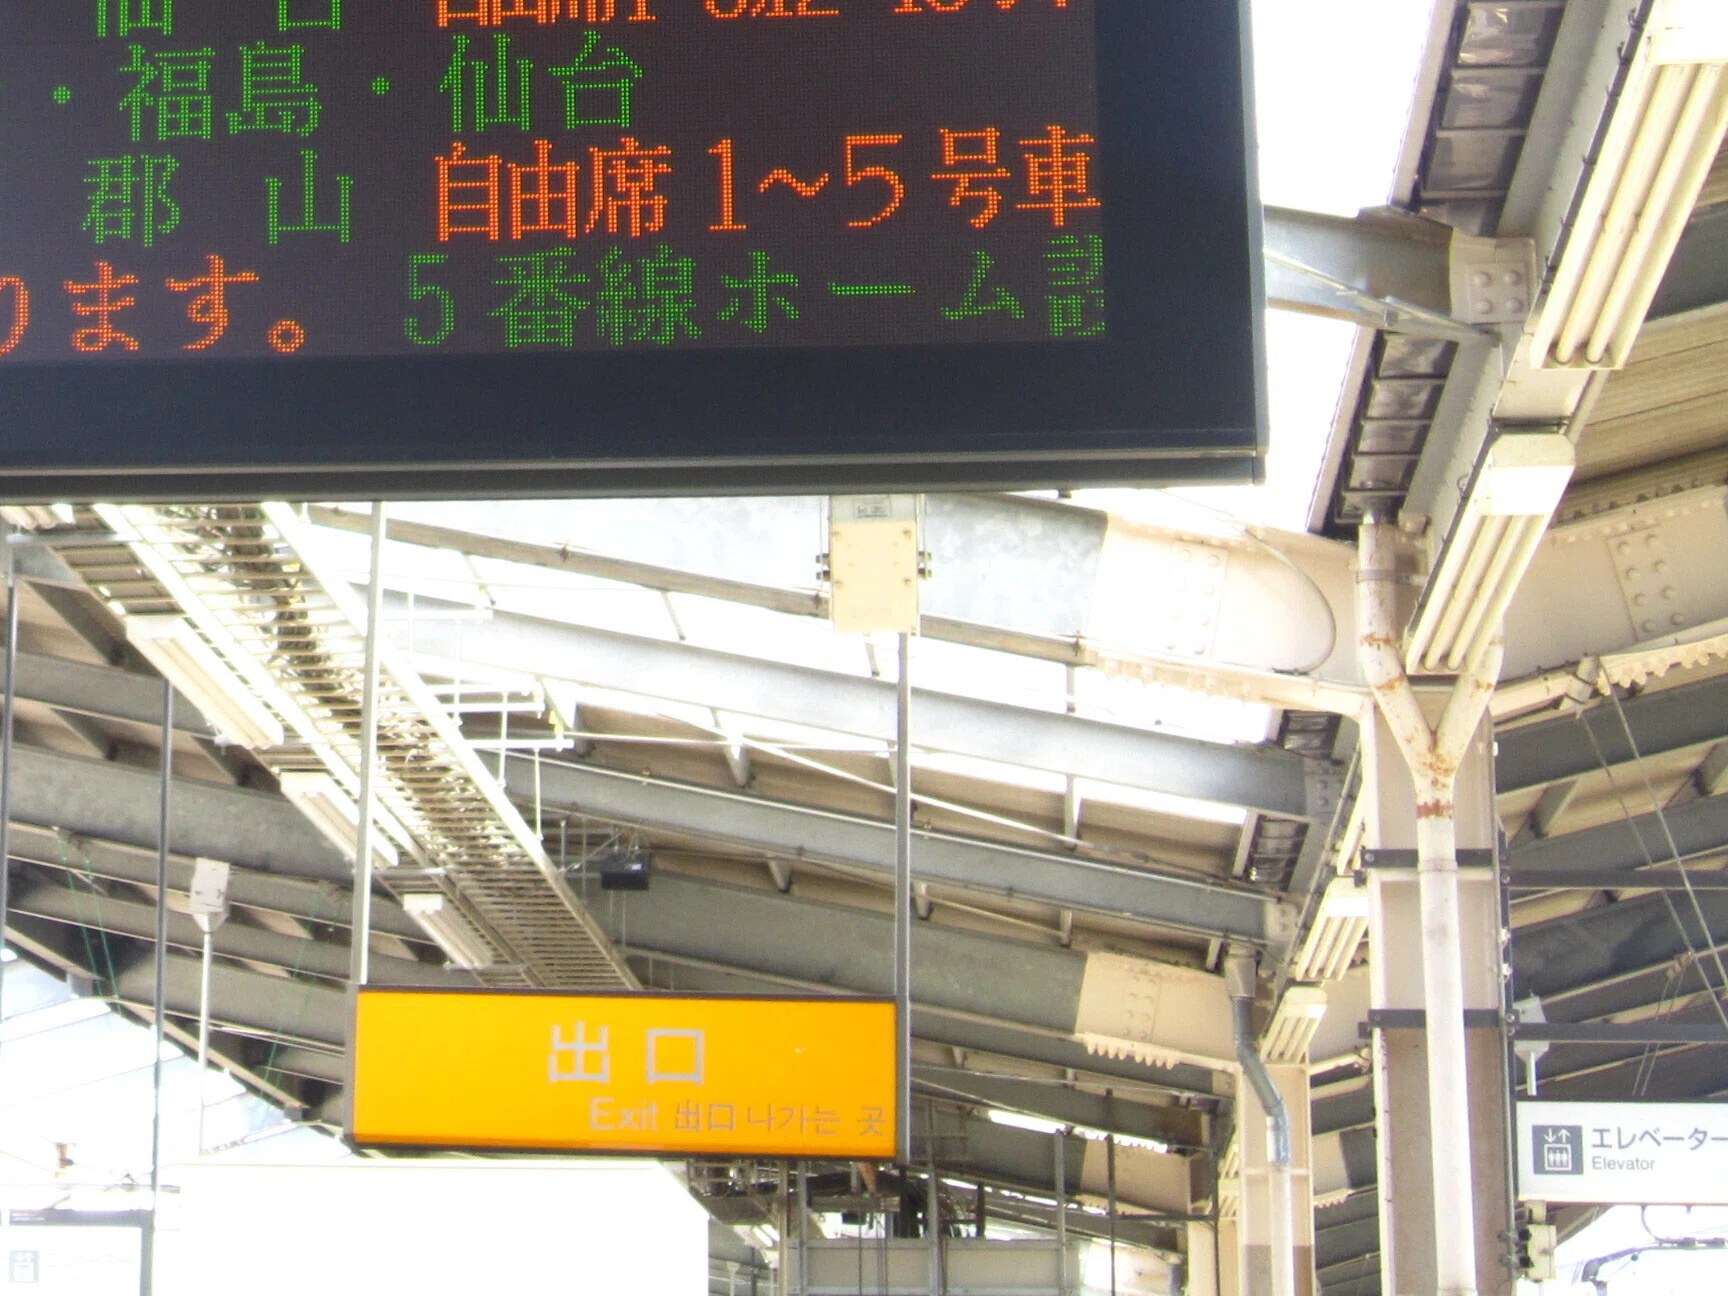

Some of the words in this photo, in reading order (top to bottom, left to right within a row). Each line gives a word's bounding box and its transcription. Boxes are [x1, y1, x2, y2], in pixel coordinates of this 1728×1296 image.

[547, 1020, 705, 1085] 出口
[588, 1097, 660, 1133] Exit
[674, 1099, 736, 1133] 出口
[1591, 1155, 1656, 1171] Elevator
